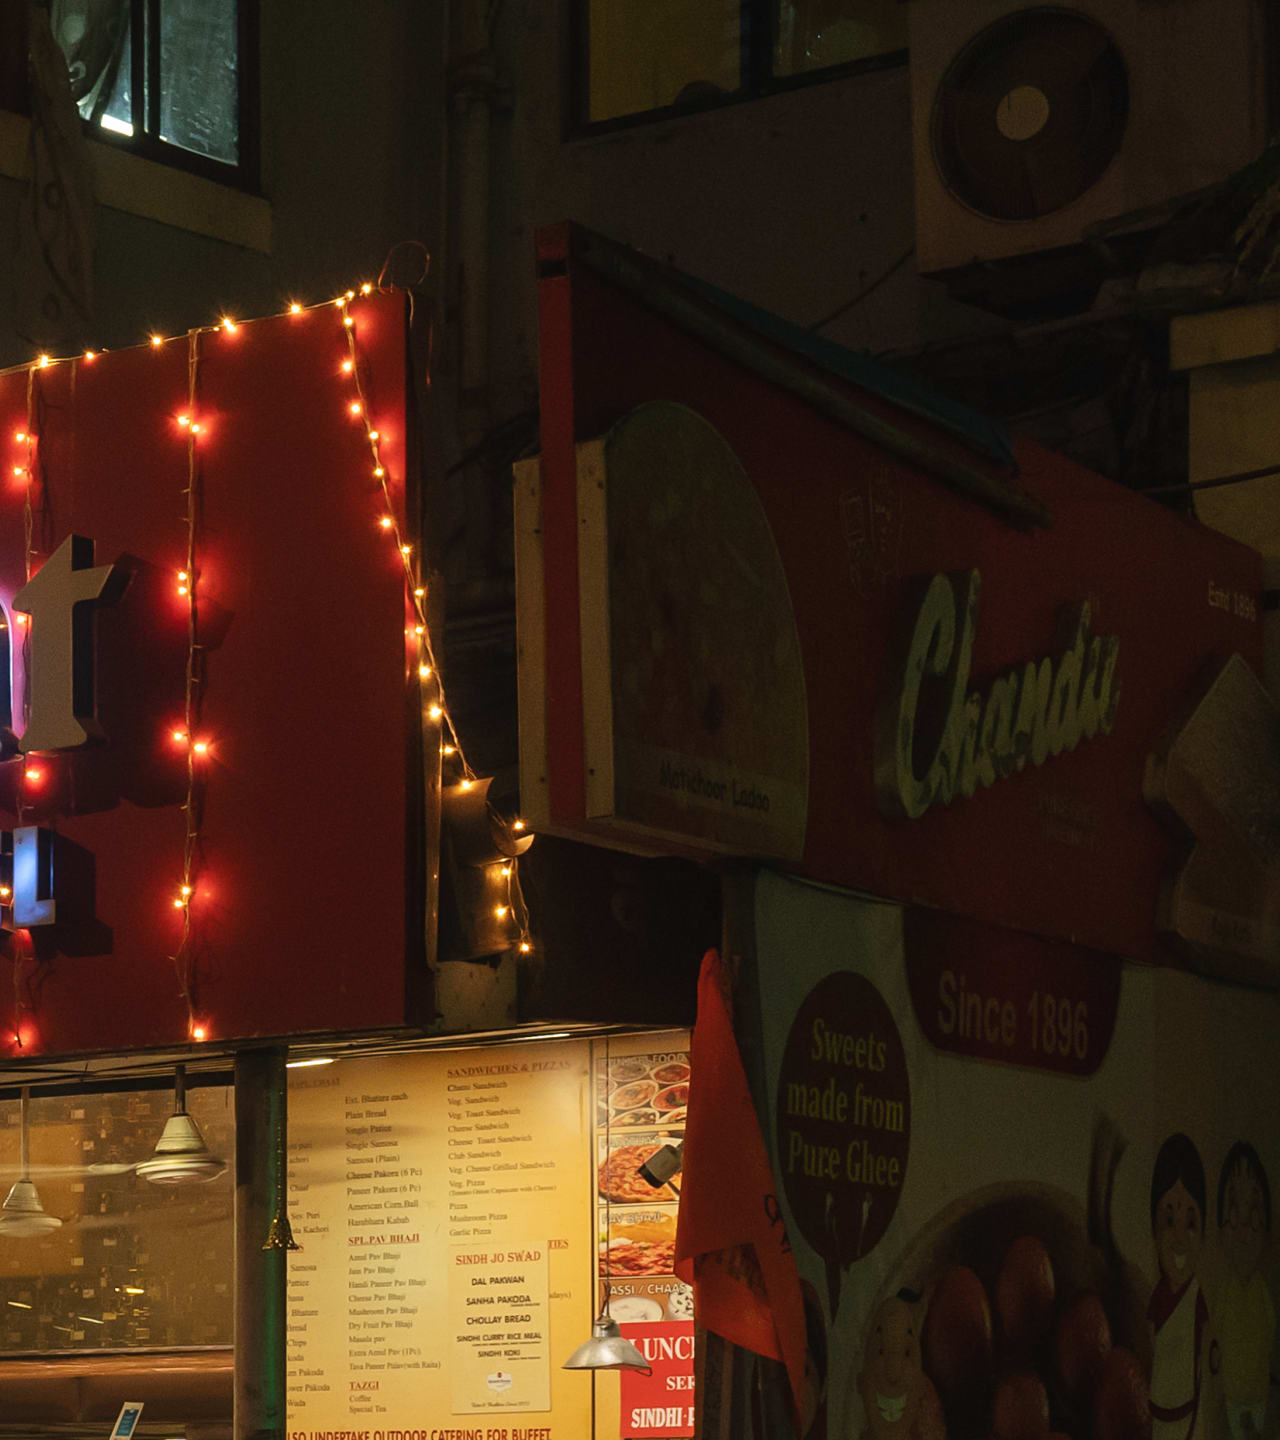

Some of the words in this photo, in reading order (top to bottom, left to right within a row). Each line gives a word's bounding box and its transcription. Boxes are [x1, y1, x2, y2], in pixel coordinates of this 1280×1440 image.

[938, 970, 1017, 1046] Since
[1026, 992, 1089, 1060] 1896
[812, 1018, 888, 1073] Sweets
[786, 1079, 848, 1123] made
[853, 1080, 904, 1133] from
[448, 1138, 473, 1147] Cheese
[346, 1157, 374, 1165] Samosa
[788, 1131, 842, 1181] Pure
[846, 1140, 901, 1188] Ghee
[346, 1171, 372, 1181] Cheese
[374, 1169, 399, 1179] Pakora
[466, 1178, 485, 1187] Pizza
[373, 1186, 398, 1195] Pakora
[347, 1202, 382, 1212] American
[449, 1203, 468, 1211] Pizza
[449, 1214, 487, 1223] Mushroom
[488, 1213, 508, 1221] Pizza
[449, 1228, 471, 1237] Garlic
[472, 1227, 492, 1236] Pizza
[389, 1232, 420, 1244] BHAJI
[348, 1253, 367, 1263] Amul
[369, 1252, 381, 1262] Pav
[383, 1251, 401, 1262] Bhaji
[456, 1253, 488, 1266] SINDH
[490, 1252, 505, 1265] JO
[507, 1250, 541, 1263] SWAD
[290, 1263, 317, 1272] Samosa
[363, 1266, 376, 1275] Pav
[378, 1265, 396, 1276] Bhaji
[370, 1279, 392, 1289] Paneer
[394, 1278, 407, 1288] Pav
[408, 1277, 427, 1289] Bhaji
[471, 1277, 487, 1287] DAL
[489, 1275, 525, 1285] PAKWAN
[609, 1284, 635, 1296] ASSI
[348, 1294, 372, 1303] Cheese
[374, 1293, 387, 1302] Pav
[388, 1292, 406, 1303] Bhaji
[466, 1297, 495, 1307] SANHA
[497, 1294, 531, 1304] PAKODA
[348, 1307, 385, 1317] Mushroom
[386, 1306, 399, 1315] Pav
[400, 1305, 418, 1316] Bhaji
[348, 1321, 362, 1332] Dry
[363, 1320, 379, 1330] Fruit
[381, 1320, 393, 1330] Pav
[395, 1319, 413, 1331] Bhaji
[466, 1316, 502, 1327] CHOLLAY
[504, 1314, 531, 1325] BREAD
[348, 1335, 373, 1344] Masala
[456, 1334, 481, 1343] SINDHI
[482, 1333, 505, 1342] CURRY
[507, 1333, 522, 1341] RICE
[524, 1332, 542, 1340] MEAL
[348, 1349, 366, 1358] Extra
[368, 1348, 386, 1357] Amul
[388, 1348, 401, 1357] Pav
[478, 1350, 501, 1359] SINDHI
[503, 1349, 521, 1358] KOKI
[350, 1380, 380, 1392] TAZGI
[349, 1394, 371, 1404] Coffee
[349, 1405, 373, 1416] Special
[374, 1405, 387, 1414] Tea
[631, 1407, 683, 1429] SINDHI
